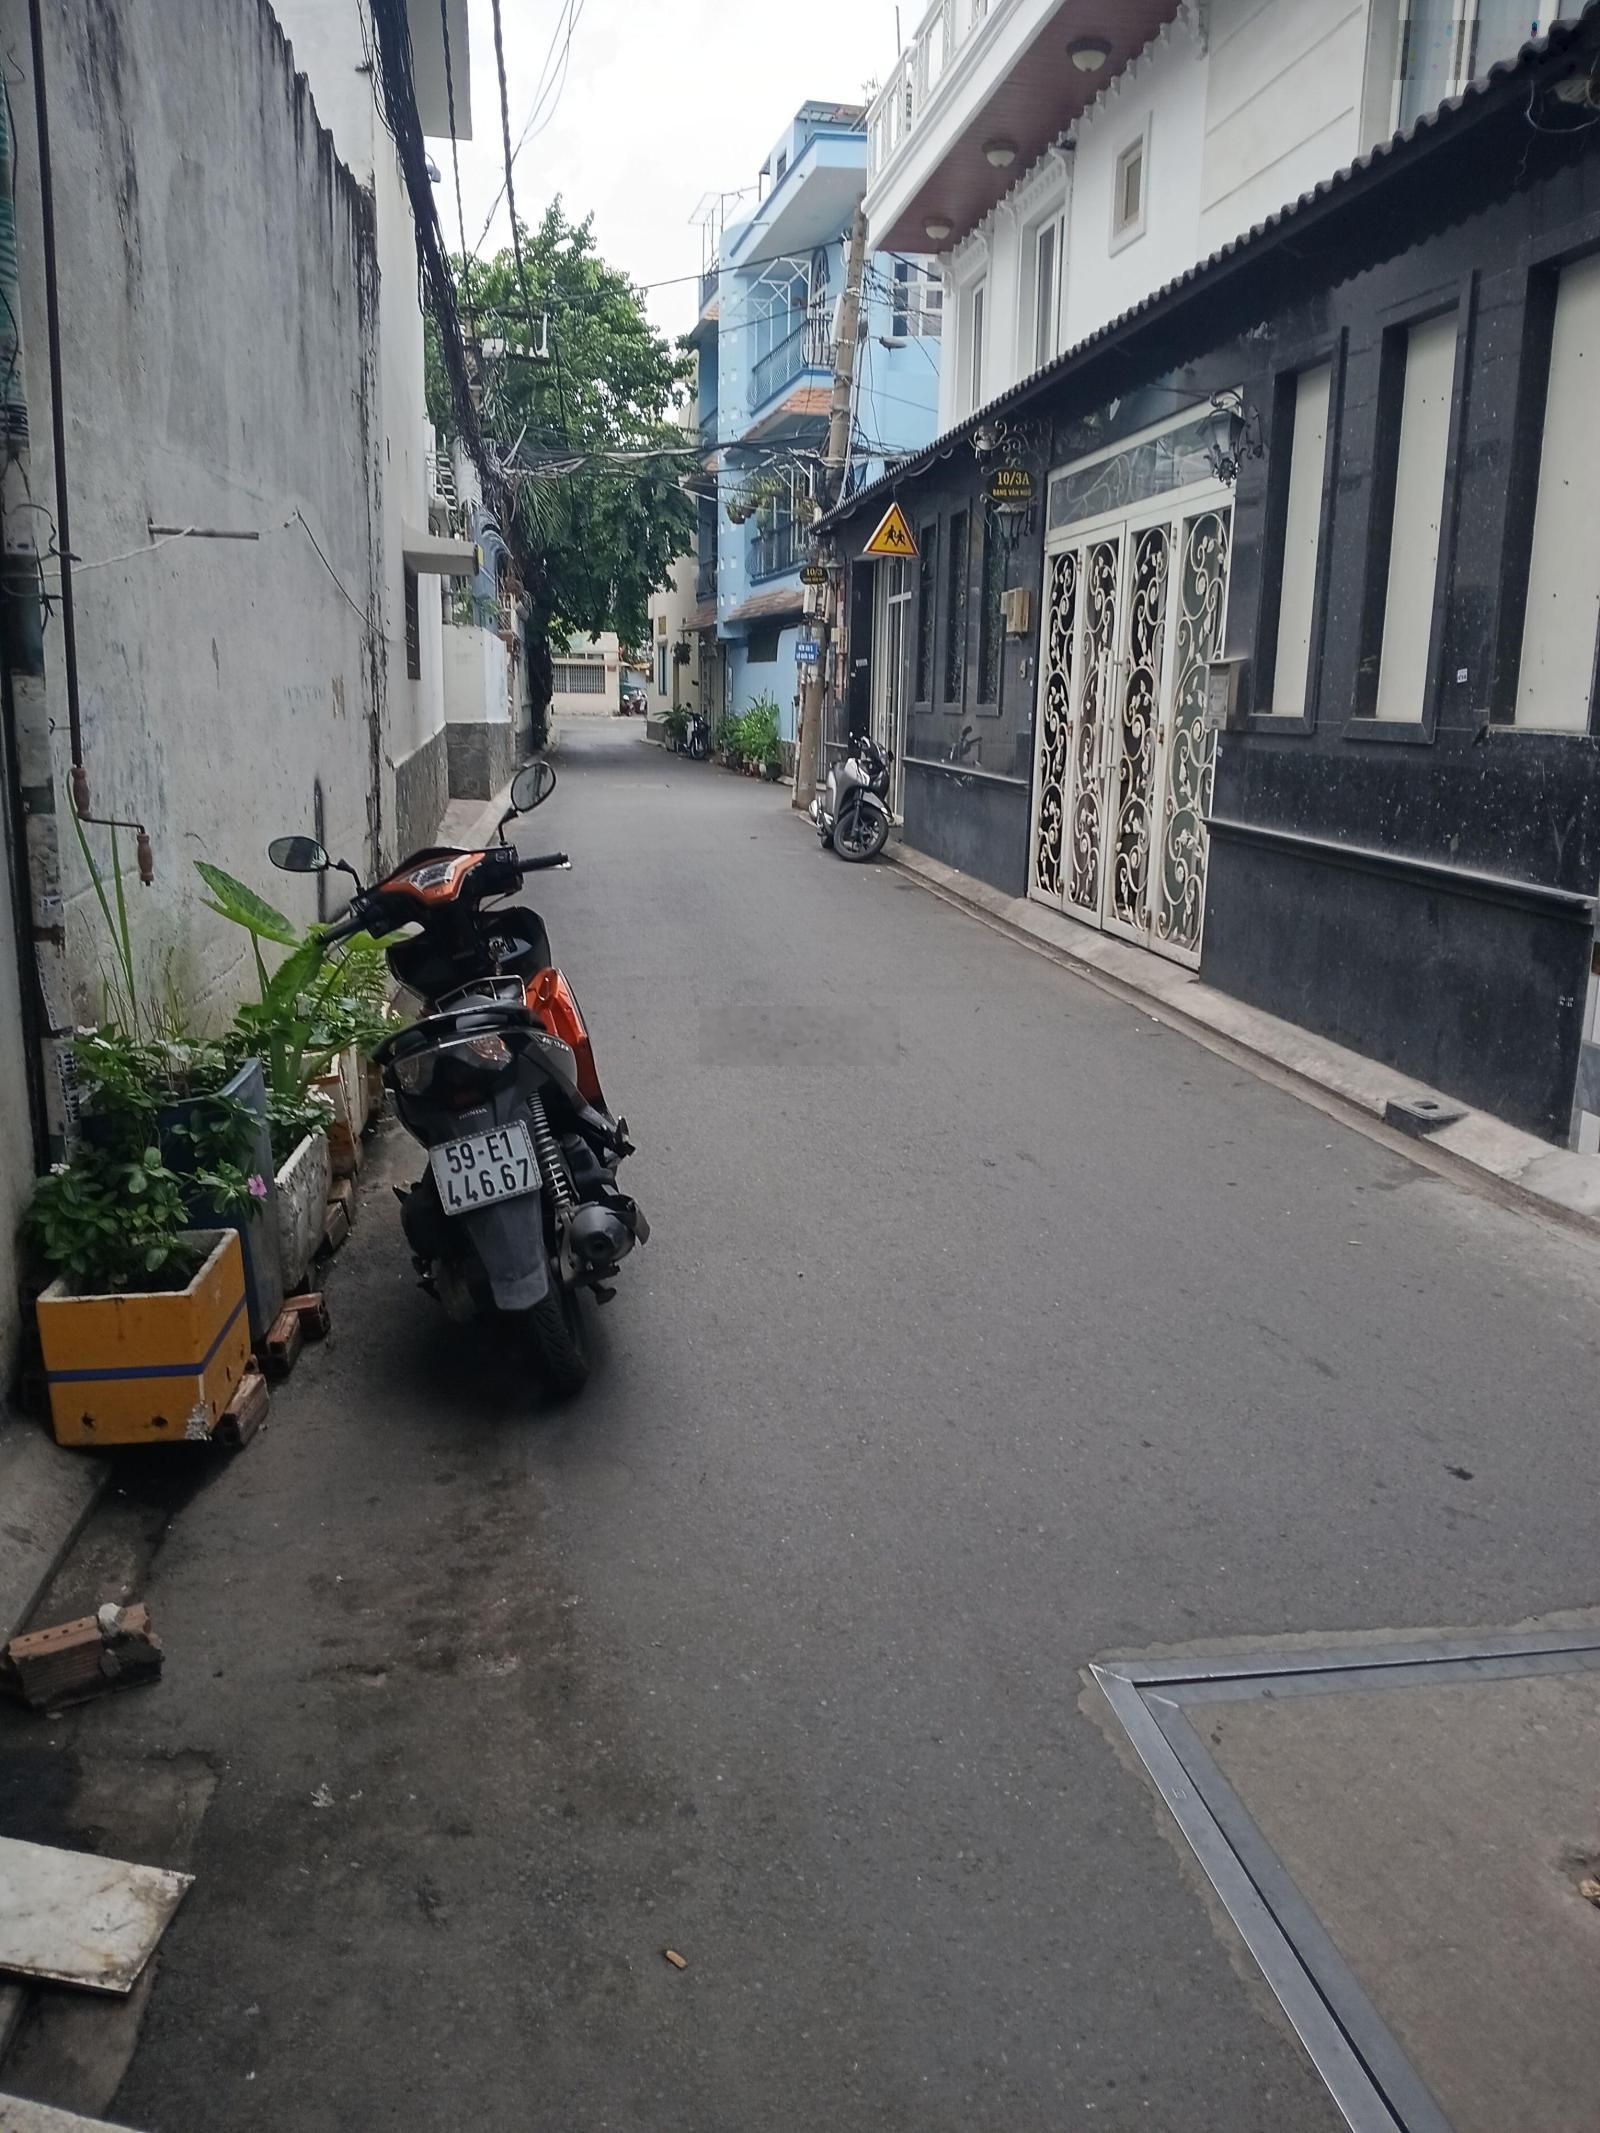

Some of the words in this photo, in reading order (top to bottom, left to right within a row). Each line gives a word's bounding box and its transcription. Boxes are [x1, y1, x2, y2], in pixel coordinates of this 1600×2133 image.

[998, 471, 1029, 485] 10/3A
[806, 567, 823, 578] 10/3
[445, 1131, 514, 1174] 59-E1
[447, 1158, 529, 1207] 446.67
